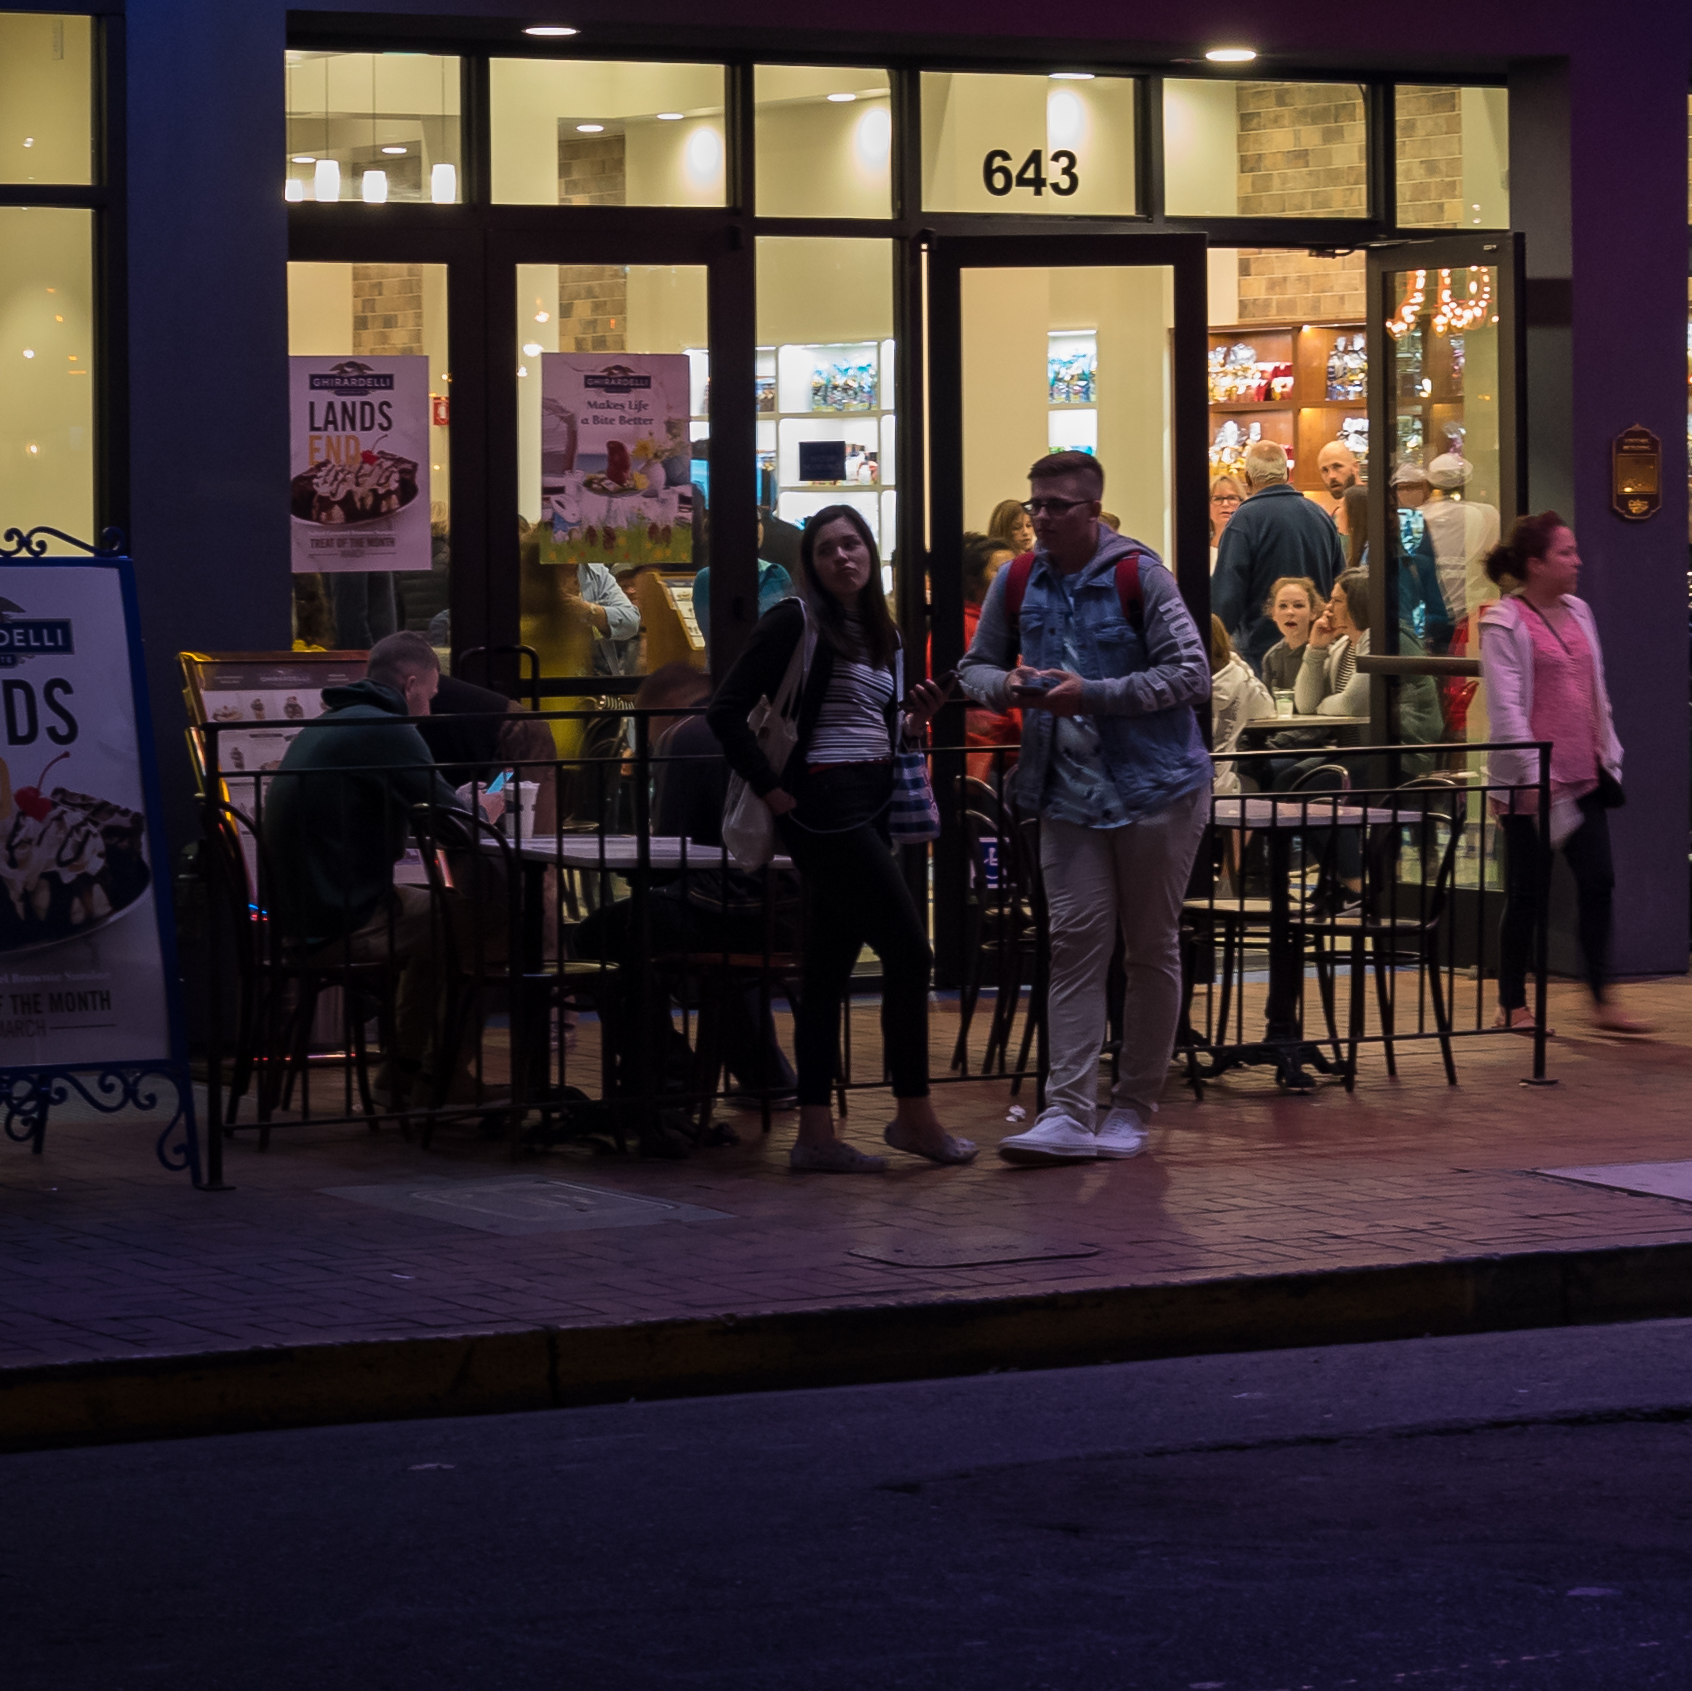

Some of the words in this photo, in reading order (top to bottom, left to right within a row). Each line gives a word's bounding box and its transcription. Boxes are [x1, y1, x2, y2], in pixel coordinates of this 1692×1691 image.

[982, 148, 1080, 198] 643
[312, 377, 391, 388] GHIRARDELLI
[586, 377, 649, 387] GHIRARDELLI
[308, 400, 394, 432] LANDS
[580, 417, 589, 425] a
[593, 414, 616, 425] Bite
[618, 414, 654, 426] Better
[586, 400, 625, 411] Makes
[628, 400, 649, 413] Life
[308, 434, 362, 467] END
[2, 677, 79, 746] DS
[10, 992, 43, 1016] THE
[49, 989, 112, 1013] MONTH
